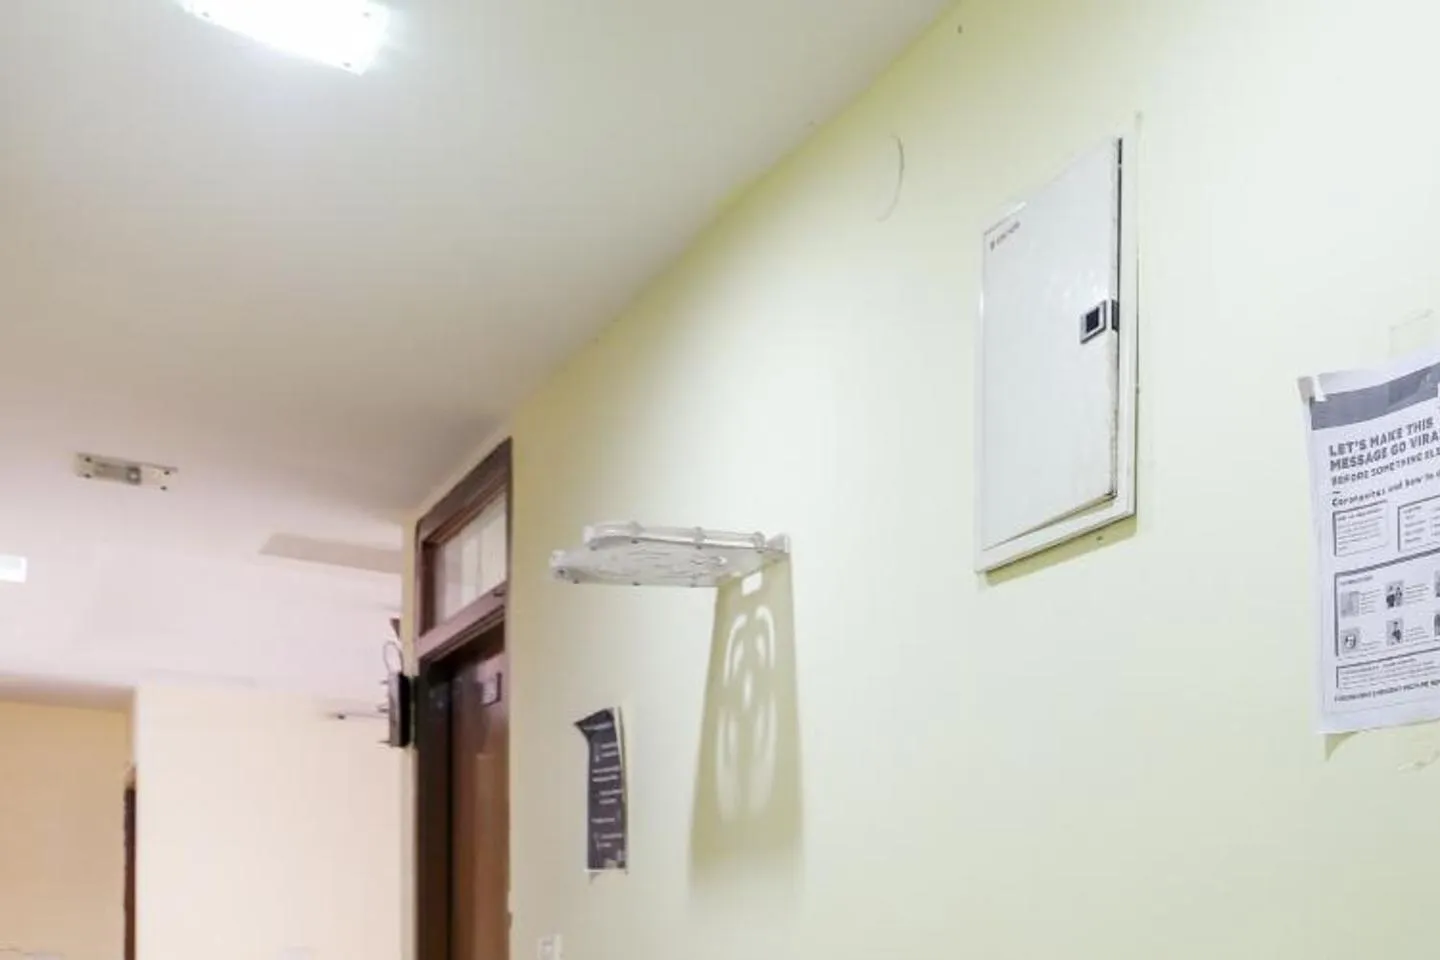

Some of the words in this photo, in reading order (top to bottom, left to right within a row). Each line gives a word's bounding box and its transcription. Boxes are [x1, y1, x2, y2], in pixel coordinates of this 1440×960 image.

[1329, 439, 1367, 457] LET'S
[1370, 427, 1403, 448] MAKE
[1406, 416, 1434, 436] THIS
[1329, 447, 1388, 472] MESSAGE
[1390, 441, 1406, 456] GO
